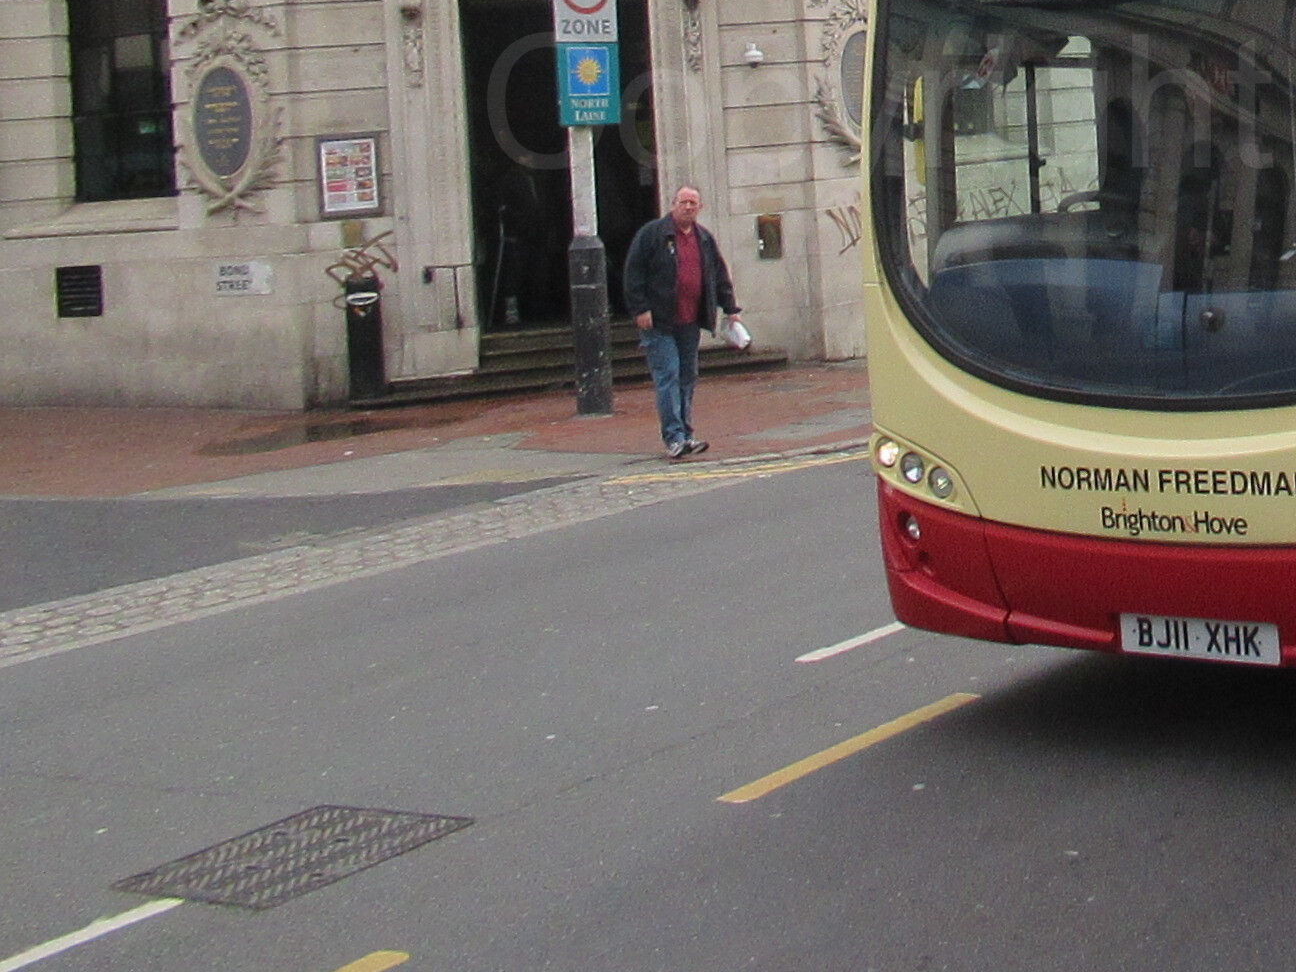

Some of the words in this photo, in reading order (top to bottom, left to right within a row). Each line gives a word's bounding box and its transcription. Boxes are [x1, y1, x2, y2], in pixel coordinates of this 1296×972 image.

[561, 19, 612, 34] ZONE
[570, 98, 610, 110] NORTH
[574, 110, 607, 122] LAINE
[1039, 465, 1150, 493] NORMAN
[1136, 617, 1189, 650] BJ11
[1204, 622, 1262, 657] XHK
